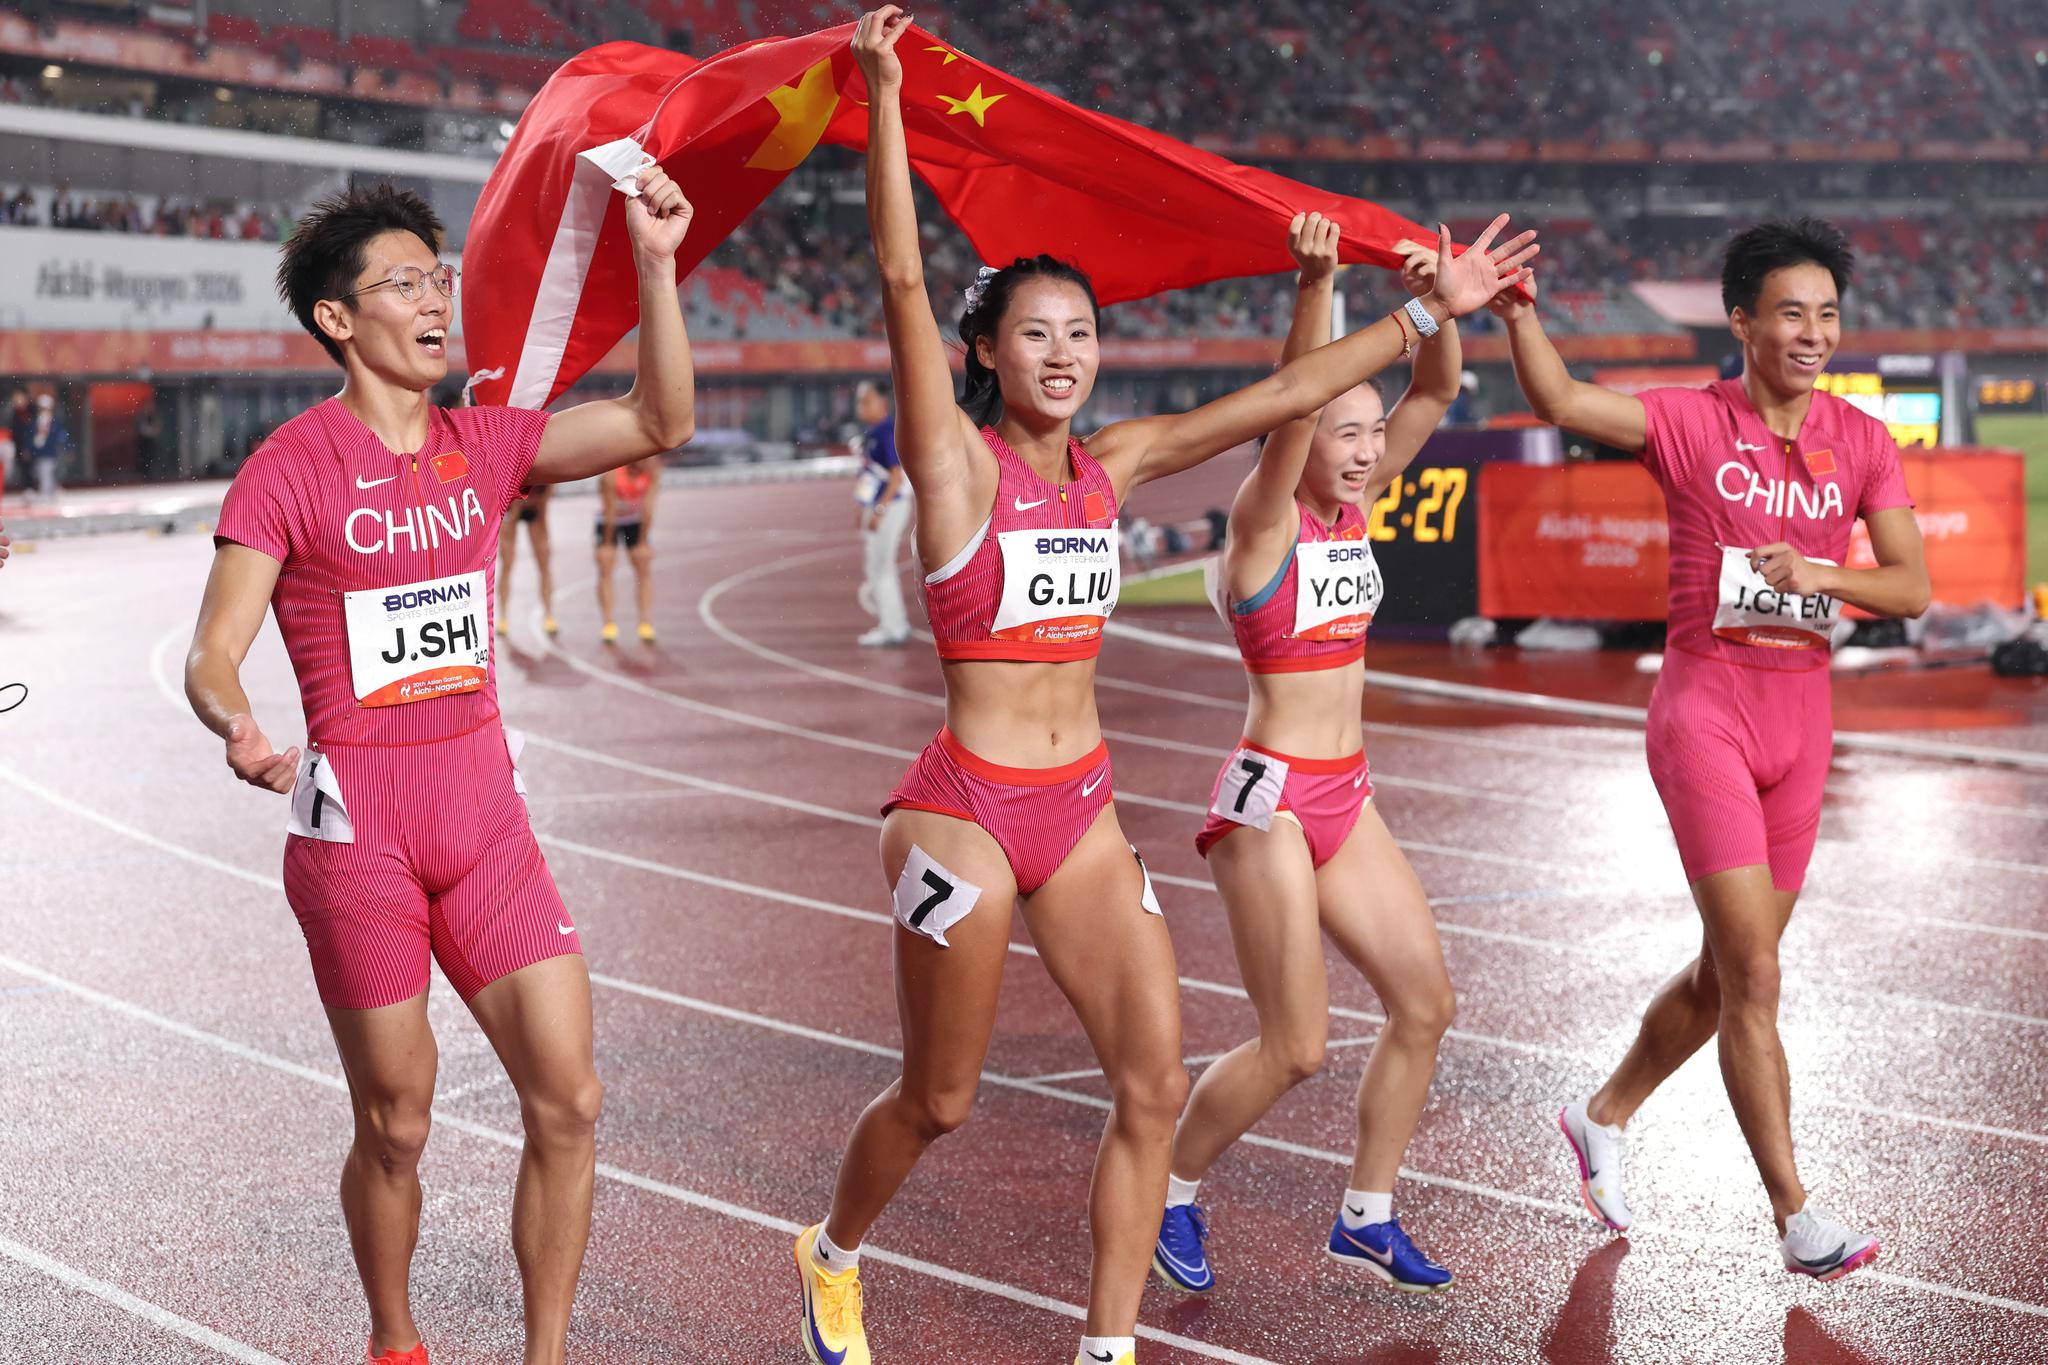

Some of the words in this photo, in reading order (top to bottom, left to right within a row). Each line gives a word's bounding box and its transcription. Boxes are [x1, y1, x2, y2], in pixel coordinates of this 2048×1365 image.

[1715, 461, 1843, 520] CHINA
[345, 488, 485, 554] CHINA
[1035, 537, 1109, 554] BORNA
[1038, 556, 1068, 565] SPORTS
[1327, 547, 1368, 562] BORN
[382, 581, 471, 612] BORNAN
[1028, 568, 1112, 605] G.LIU
[1310, 570, 1381, 607] Y.CHEN
[387, 610, 422, 622] SPORTS
[424, 600, 471, 616] TECHNOLOGY
[381, 614, 479, 664] J.SHI
[412, 681, 427, 689] 20th
[427, 678, 443, 686] Asian
[443, 675, 462, 683] Games
[413, 682, 463, 696] Aichi-Nagoya
[463, 677, 480, 687] 2026
[1233, 759, 1266, 814] 7
[909, 868, 955, 928] 7
